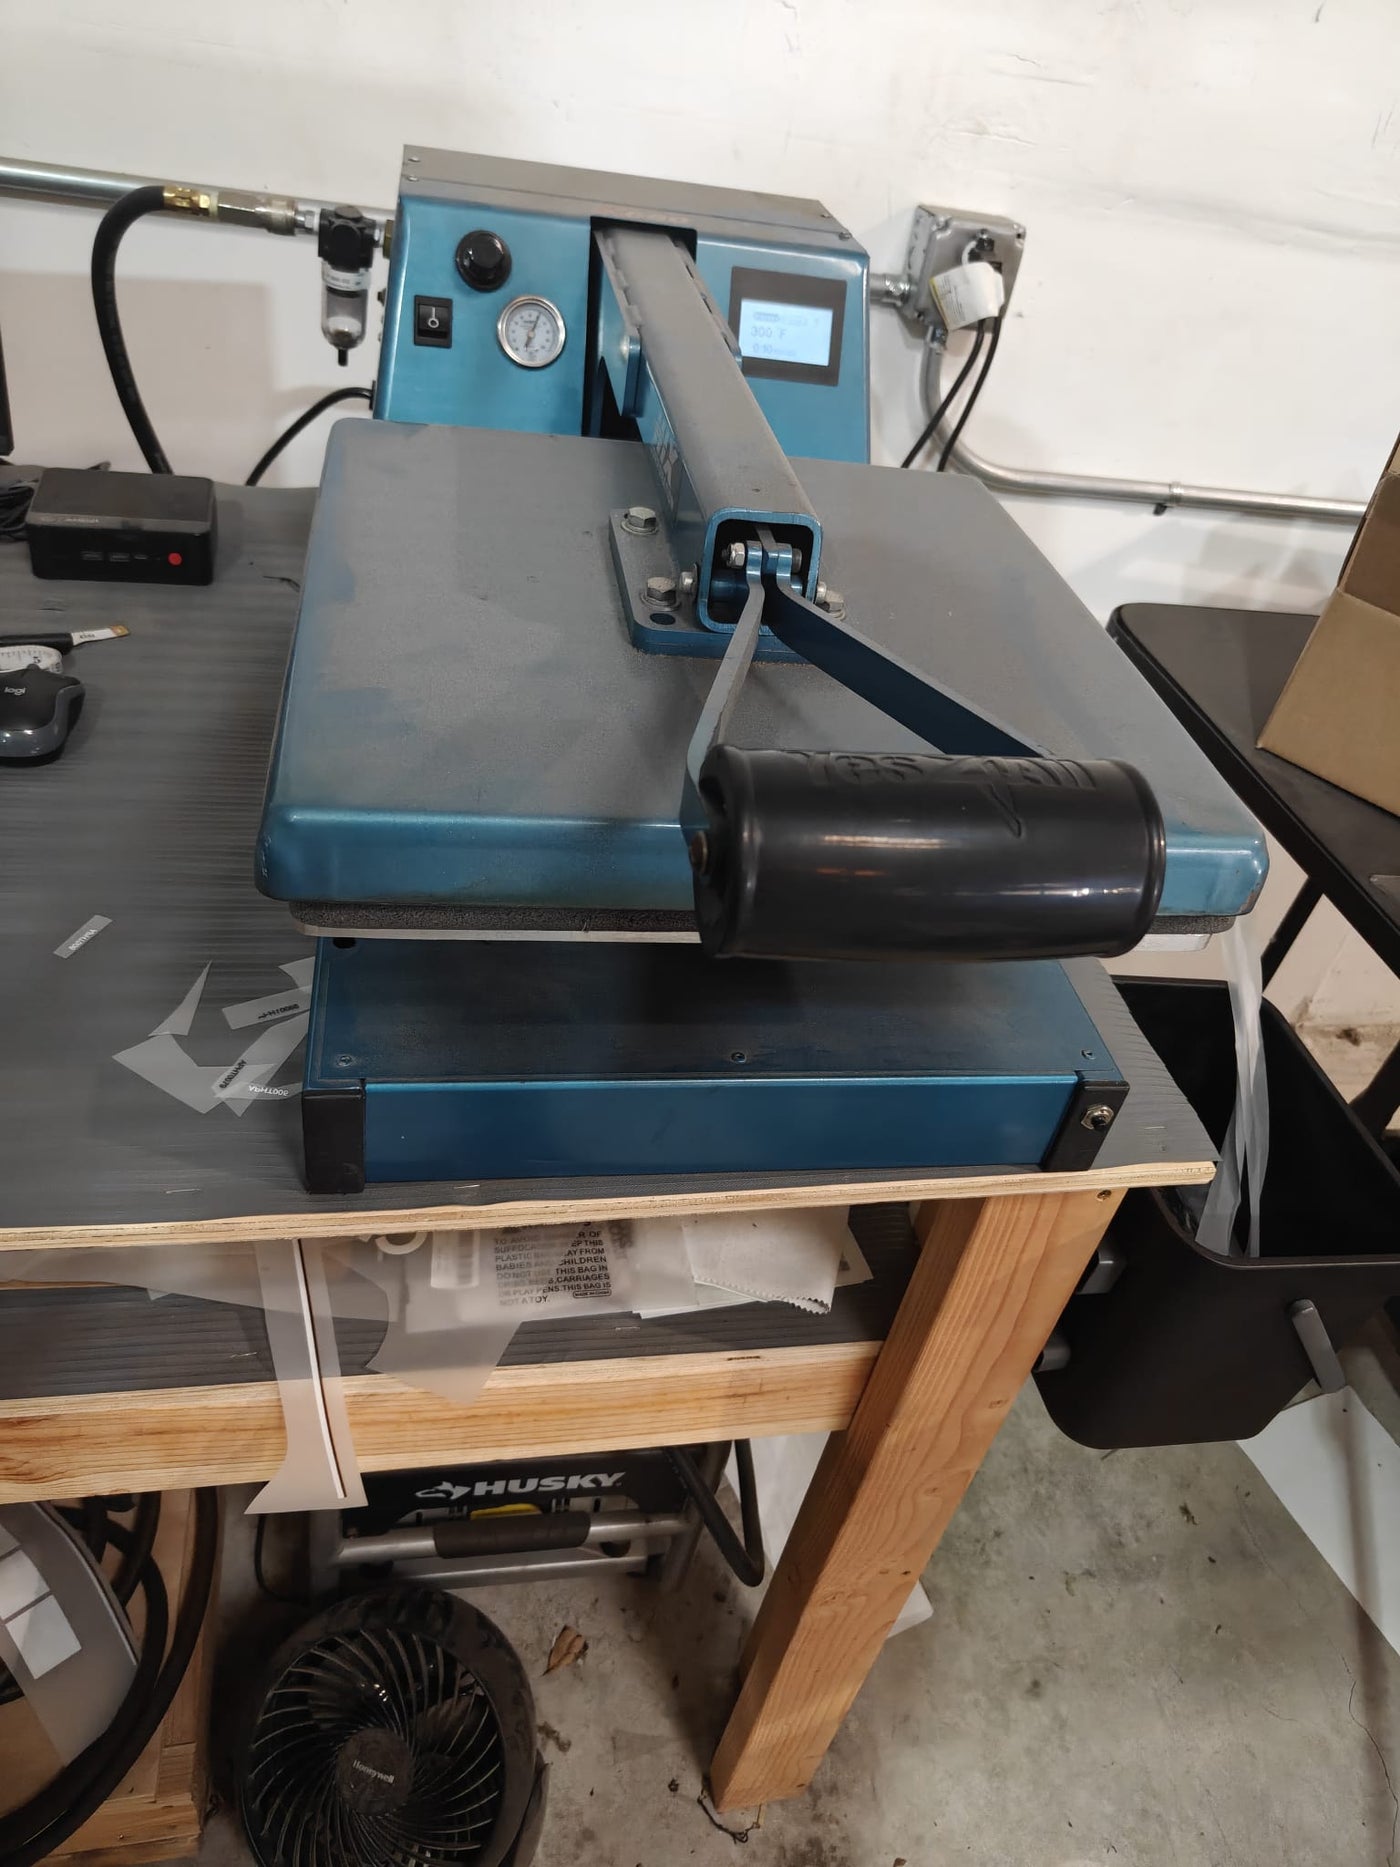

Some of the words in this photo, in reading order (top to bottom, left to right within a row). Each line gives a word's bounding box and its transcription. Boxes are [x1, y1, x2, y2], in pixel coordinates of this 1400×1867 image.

[4, 686, 26, 696] logi
[579, 1247, 605, 1255] FROM
[556, 1267, 576, 1275] THIS
[578, 1265, 597, 1274] BAG
[583, 1281, 602, 1290] BAG
[474, 1471, 626, 1496] HUSKY
[353, 1760, 394, 1783] Honeywell
